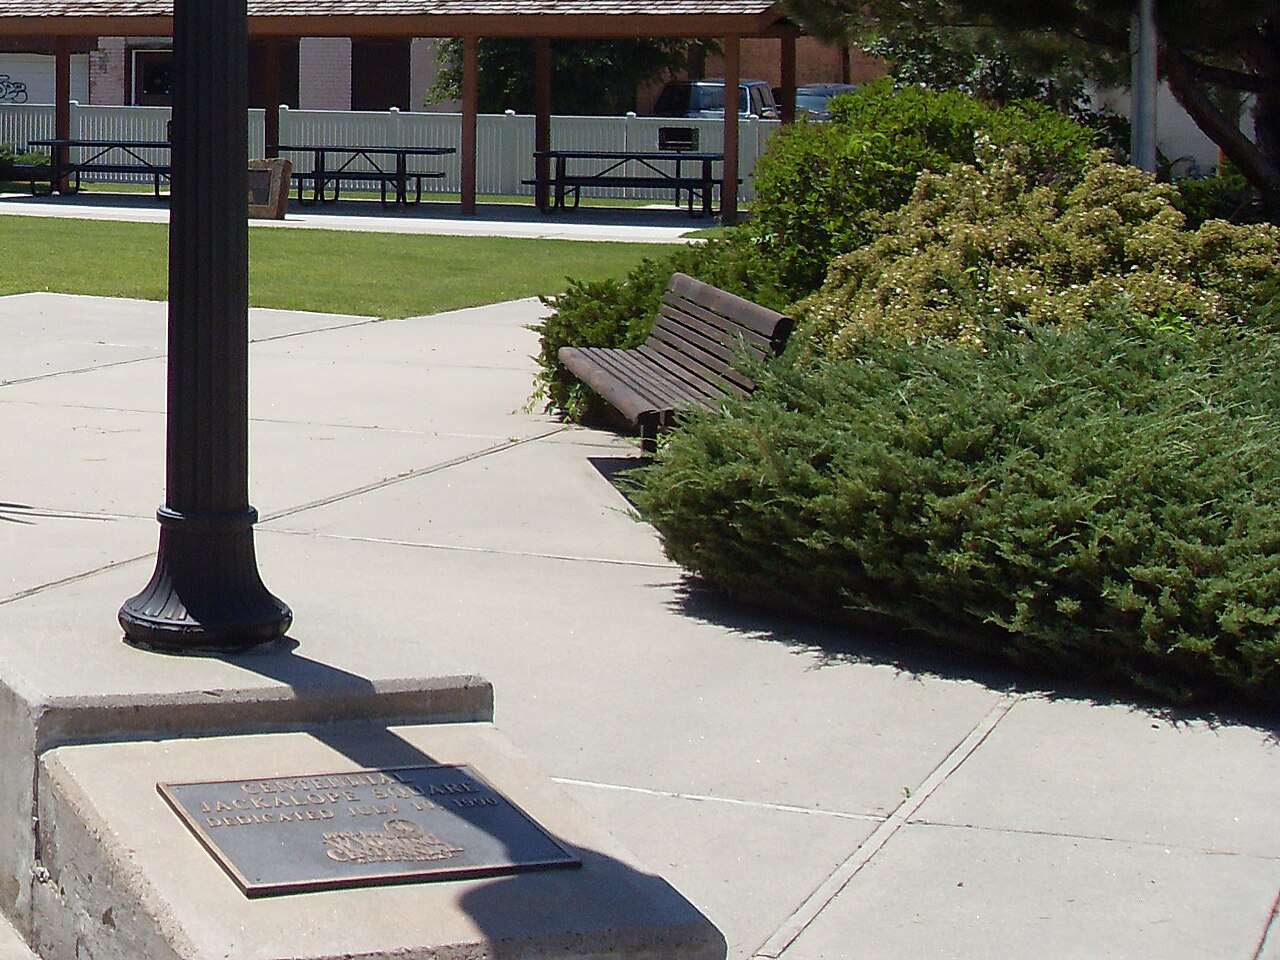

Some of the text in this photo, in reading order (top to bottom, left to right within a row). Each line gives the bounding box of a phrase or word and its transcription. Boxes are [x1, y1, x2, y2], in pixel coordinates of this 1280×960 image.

[241, 773, 414, 794] CENTENNIAL
[201, 783, 480, 813] JACKALOPE SQUARE
[206, 809, 335, 828] DEDICATED
[347, 803, 398, 817] JULY
